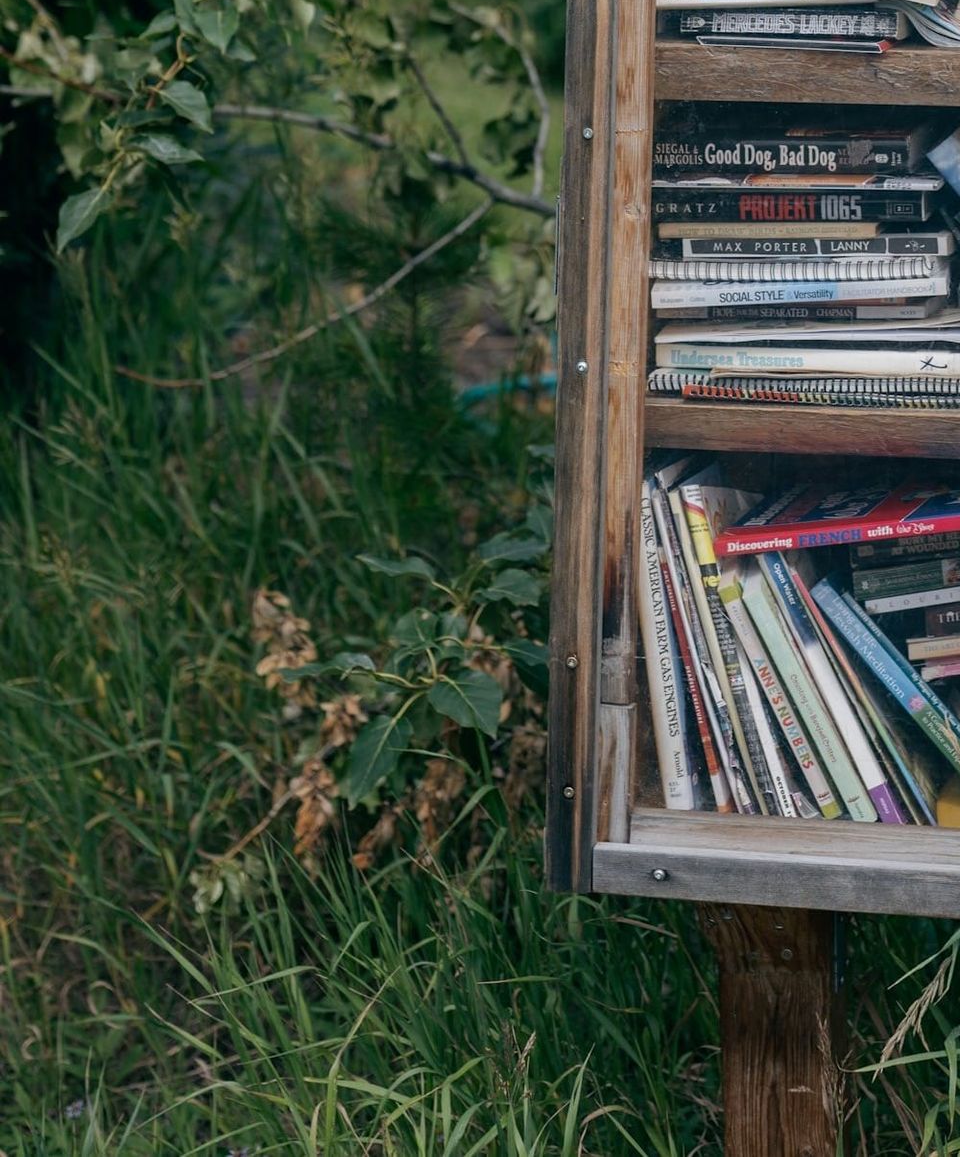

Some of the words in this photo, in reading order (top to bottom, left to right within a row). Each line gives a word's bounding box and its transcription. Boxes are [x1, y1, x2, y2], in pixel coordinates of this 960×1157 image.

[711, 12, 794, 34] MERCEDES
[800, 14, 858, 34] LACKEY
[654, 154, 703, 165] MARGOLIS
[656, 143, 690, 155] SIEGAL
[705, 143, 741, 165] Good
[744, 145, 776, 171] Dog,
[779, 145, 805, 166] Bad
[808, 146, 837, 172] Dog
[656, 202, 718, 214] GRATZ
[739, 195, 817, 221] PROJEKT
[820, 195, 863, 221] 1065
[713, 243, 742, 253] MAX
[755, 242, 807, 253] PORTER
[830, 241, 870, 253] LANNY
[719, 291, 754, 303] SOCIAL
[756, 290, 784, 301] STYLE
[793, 288, 835, 301] Versatility
[712, 307, 737, 318] HOPE
[759, 306, 809, 318] SEPARATED
[816, 307, 856, 318] CHAPMAN
[670, 349, 733, 367] Undersea
[736, 351, 804, 368] Treasures
[641, 497, 655, 548] CLASSIC
[727, 536, 792, 553] Discovering
[799, 529, 862, 547] FRENCH
[868, 524, 894, 537] with
[903, 539, 960, 554] WOUNDED
[645, 549, 665, 618] AMERICAN
[772, 562, 786, 581] Open
[782, 580, 796, 606] Water
[655, 618, 671, 651] FARM
[831, 597, 855, 621] Living
[861, 629, 877, 648] Life
[660, 652, 672, 685] GAS
[836, 614, 861, 643] Jewish
[861, 643, 906, 699] Meditation
[662, 686, 680, 738] ENGINES
[753, 657, 784, 705] ANNE'S
[778, 707, 814, 770] NUMBERS
[673, 749, 684, 779] Arnold
[775, 775, 792, 808] OCTOBER
